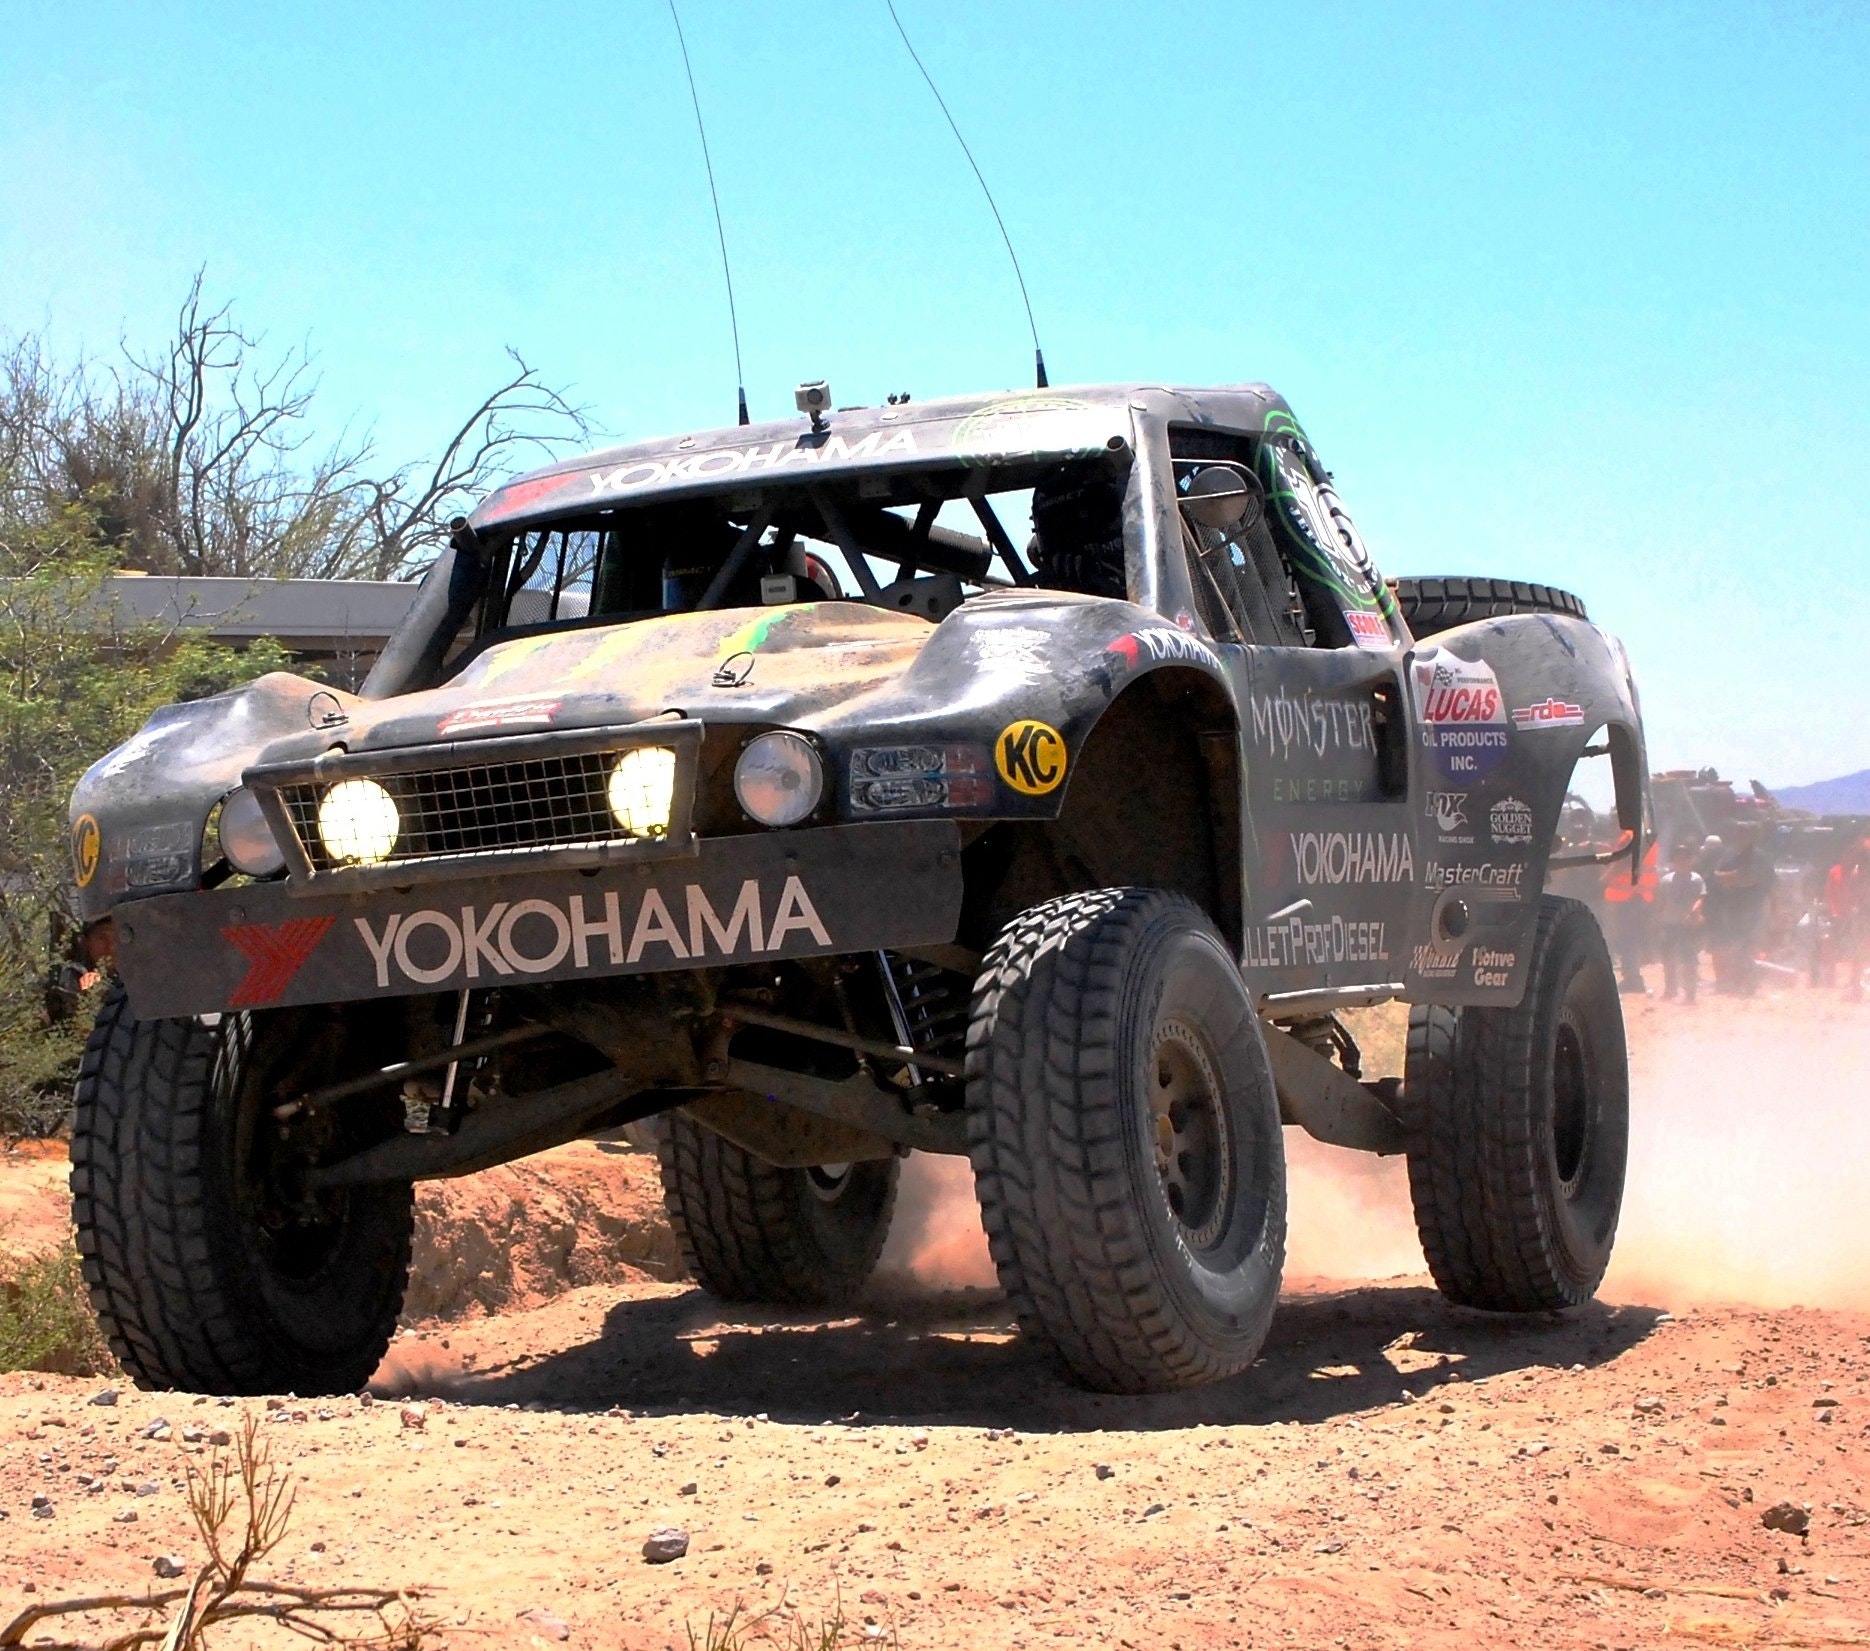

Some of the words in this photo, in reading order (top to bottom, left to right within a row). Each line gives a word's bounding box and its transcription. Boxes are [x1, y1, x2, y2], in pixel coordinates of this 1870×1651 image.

[589, 428, 918, 497] YOKOHAMA
[1424, 689, 1496, 722] LUCAS
[1251, 685, 1378, 760] MONSTER
[1422, 732, 1438, 747] OIL
[1441, 731, 1507, 747] PRODUCTS
[1004, 725, 1057, 787] KC
[1451, 755, 1478, 771] INC.
[1273, 778, 1364, 801] ENERGY
[1490, 813, 1532, 823] GOLDEN
[1491, 823, 1532, 834] NUGGET
[1290, 832, 1414, 884] YOKOHAMA
[354, 875, 833, 988] YOKOHAMA
[1474, 967, 1509, 987] Gear
